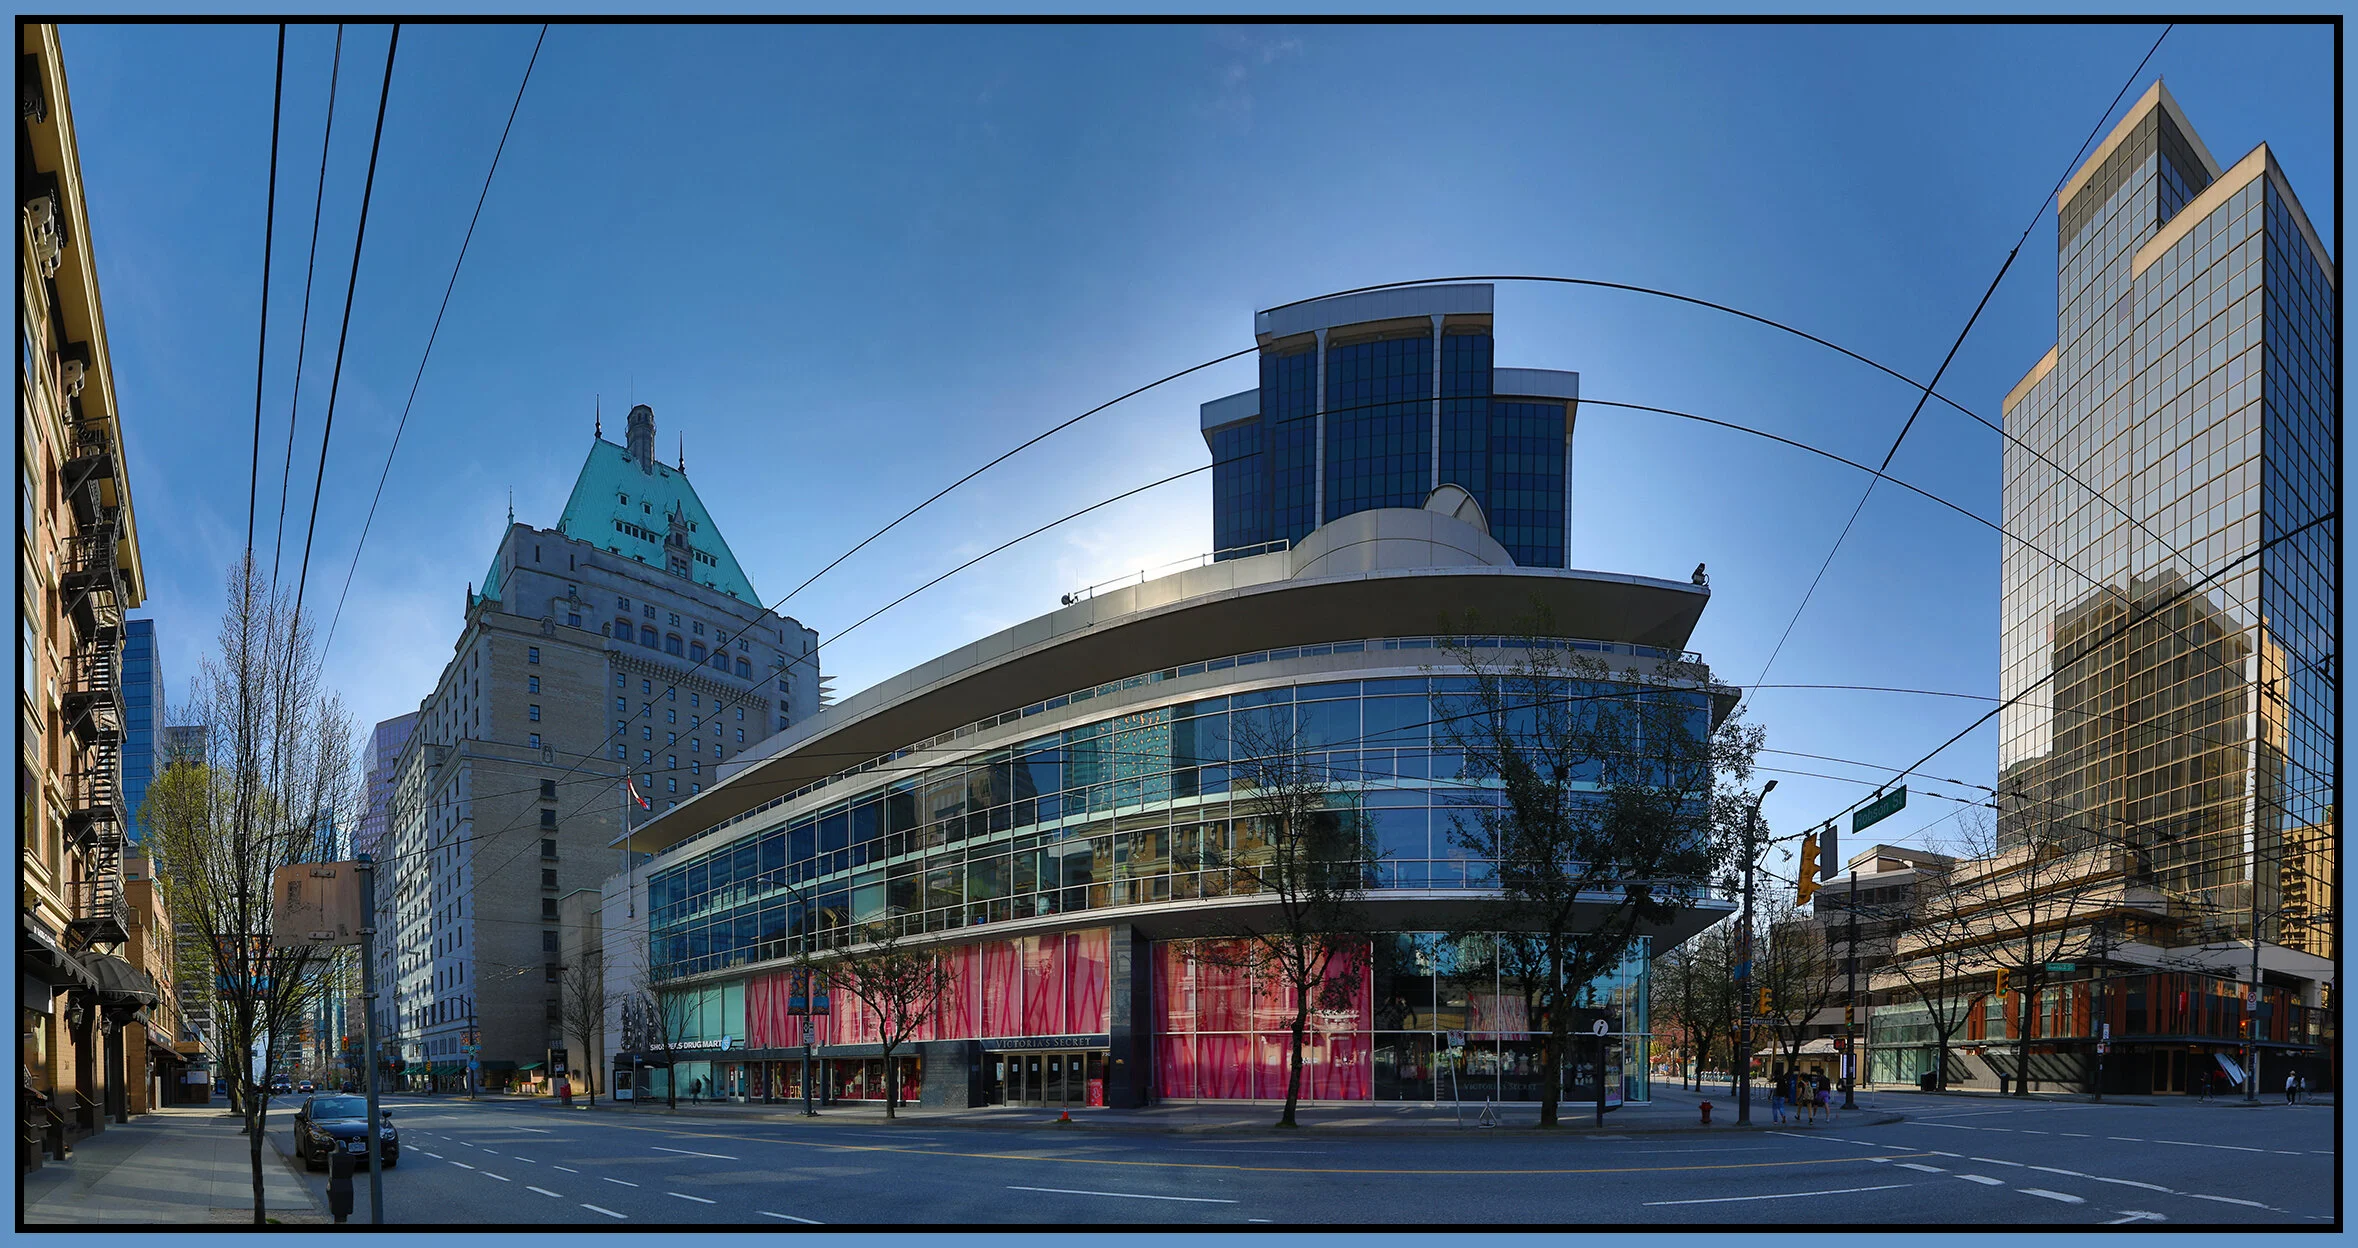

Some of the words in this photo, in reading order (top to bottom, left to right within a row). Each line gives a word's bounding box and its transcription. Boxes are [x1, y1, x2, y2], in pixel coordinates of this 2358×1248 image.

[1855, 802, 1889, 828] Robson
[683, 1041, 702, 1049] DRUG
[702, 1039, 722, 1048] MART
[996, 1039, 1050, 1048] VICTORIA'S
[1053, 1037, 1092, 1047] SECRET
